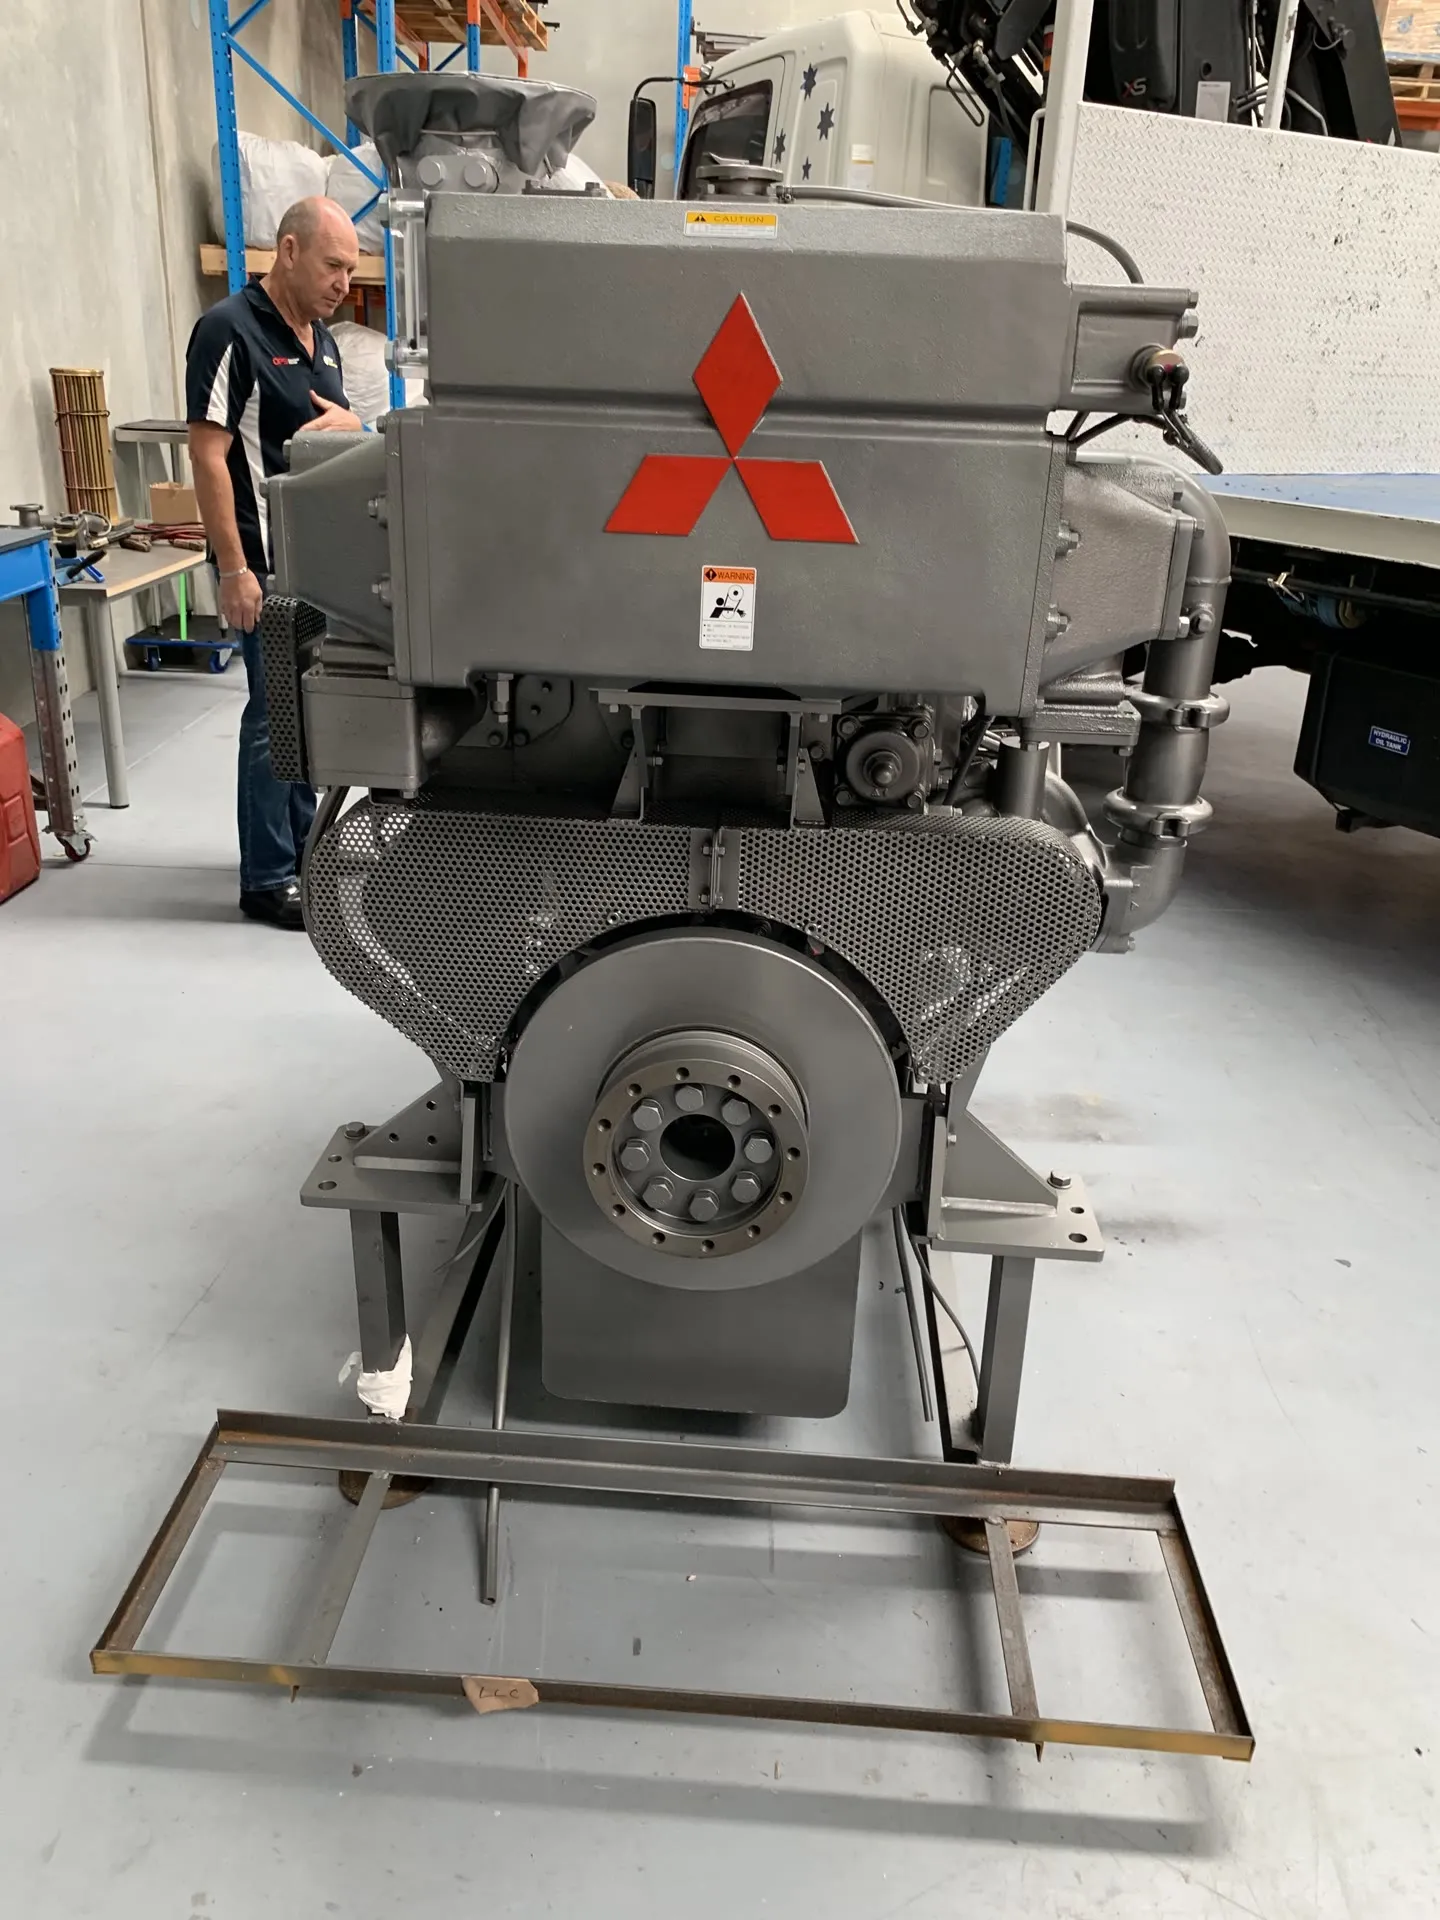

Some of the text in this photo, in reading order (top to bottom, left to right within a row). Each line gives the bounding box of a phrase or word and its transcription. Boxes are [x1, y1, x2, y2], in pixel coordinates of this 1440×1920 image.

[1122, 77, 1147, 98] XS
[713, 215, 765, 224] CAUTION
[717, 571, 755, 581] WARNING
[1373, 729, 1408, 745] HYDRAULIC
[1375, 738, 1402, 751] OIL TANK
